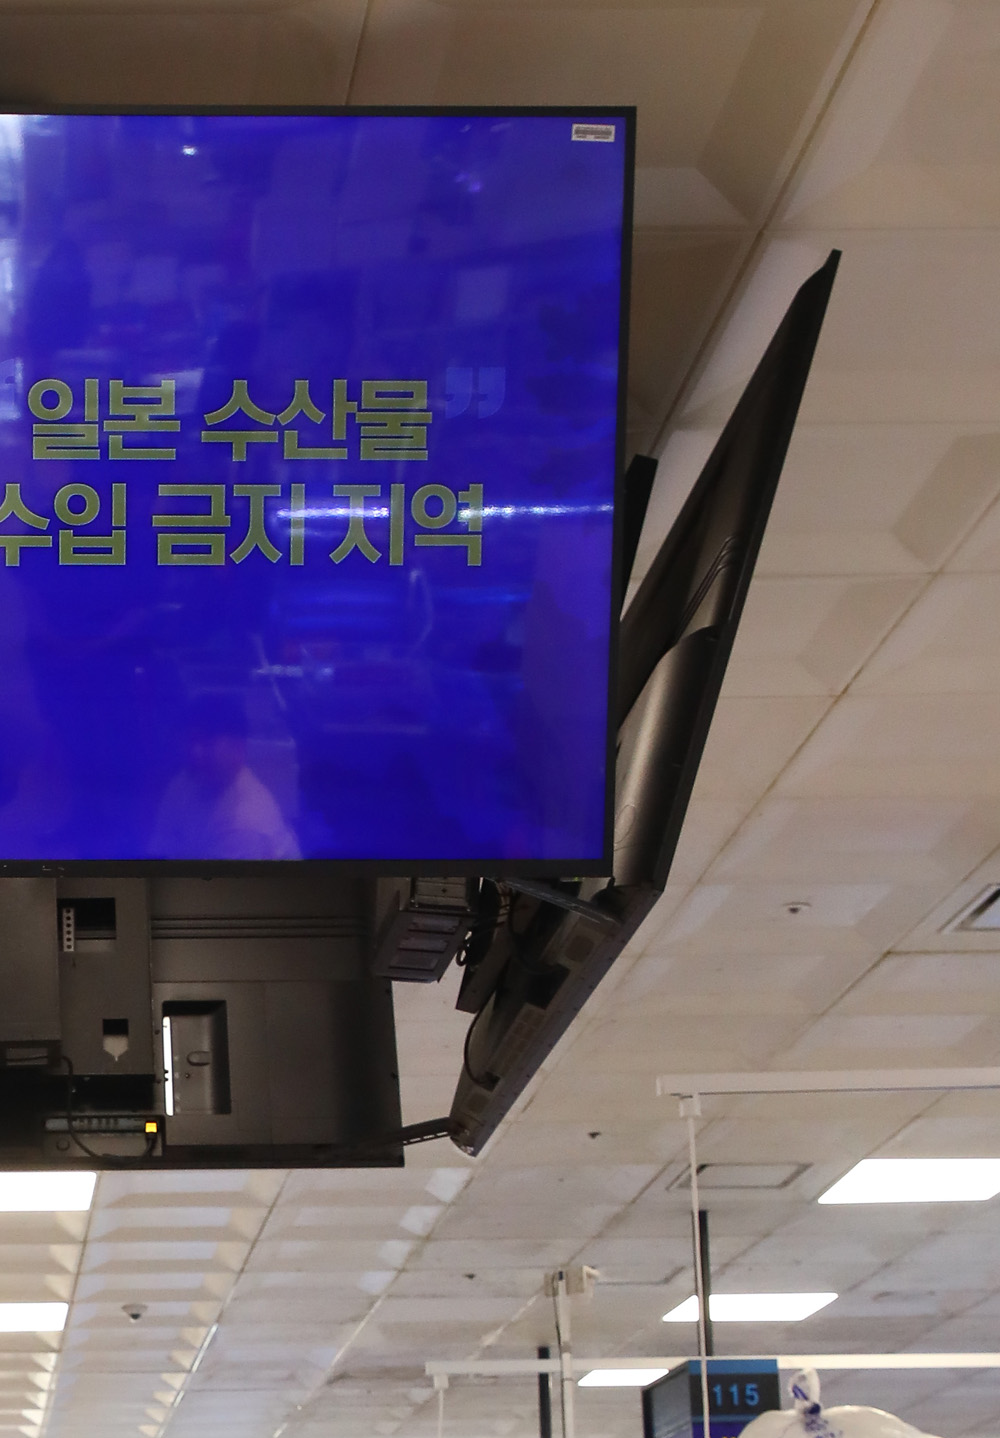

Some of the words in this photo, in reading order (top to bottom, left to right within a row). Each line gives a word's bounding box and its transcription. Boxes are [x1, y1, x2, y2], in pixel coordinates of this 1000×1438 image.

[152, 483, 306, 567] 금지
[330, 483, 484, 567] 지역
[712, 1383, 760, 1407] 115
